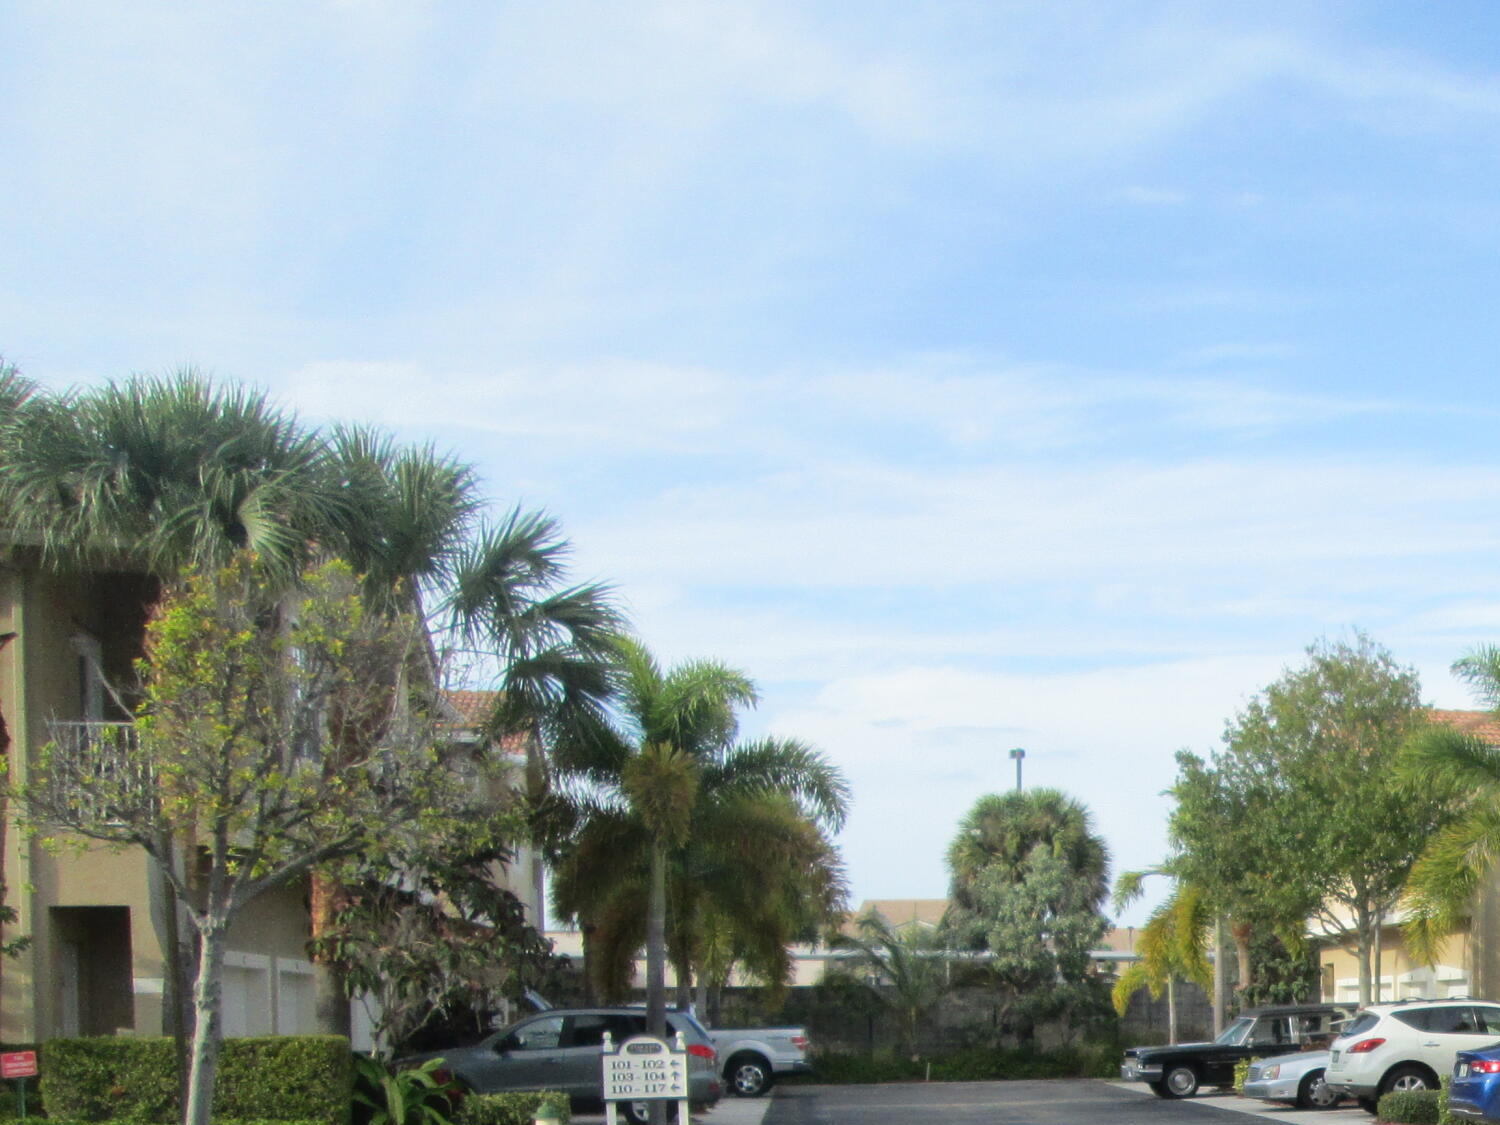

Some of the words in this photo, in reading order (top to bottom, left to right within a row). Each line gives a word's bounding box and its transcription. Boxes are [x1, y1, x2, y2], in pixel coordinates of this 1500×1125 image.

[612, 1060, 631, 1070] 101
[642, 1059, 665, 1069] 102
[612, 1072, 633, 1082] 103
[612, 1084, 632, 1094] 110
[644, 1083, 666, 1093] 117
